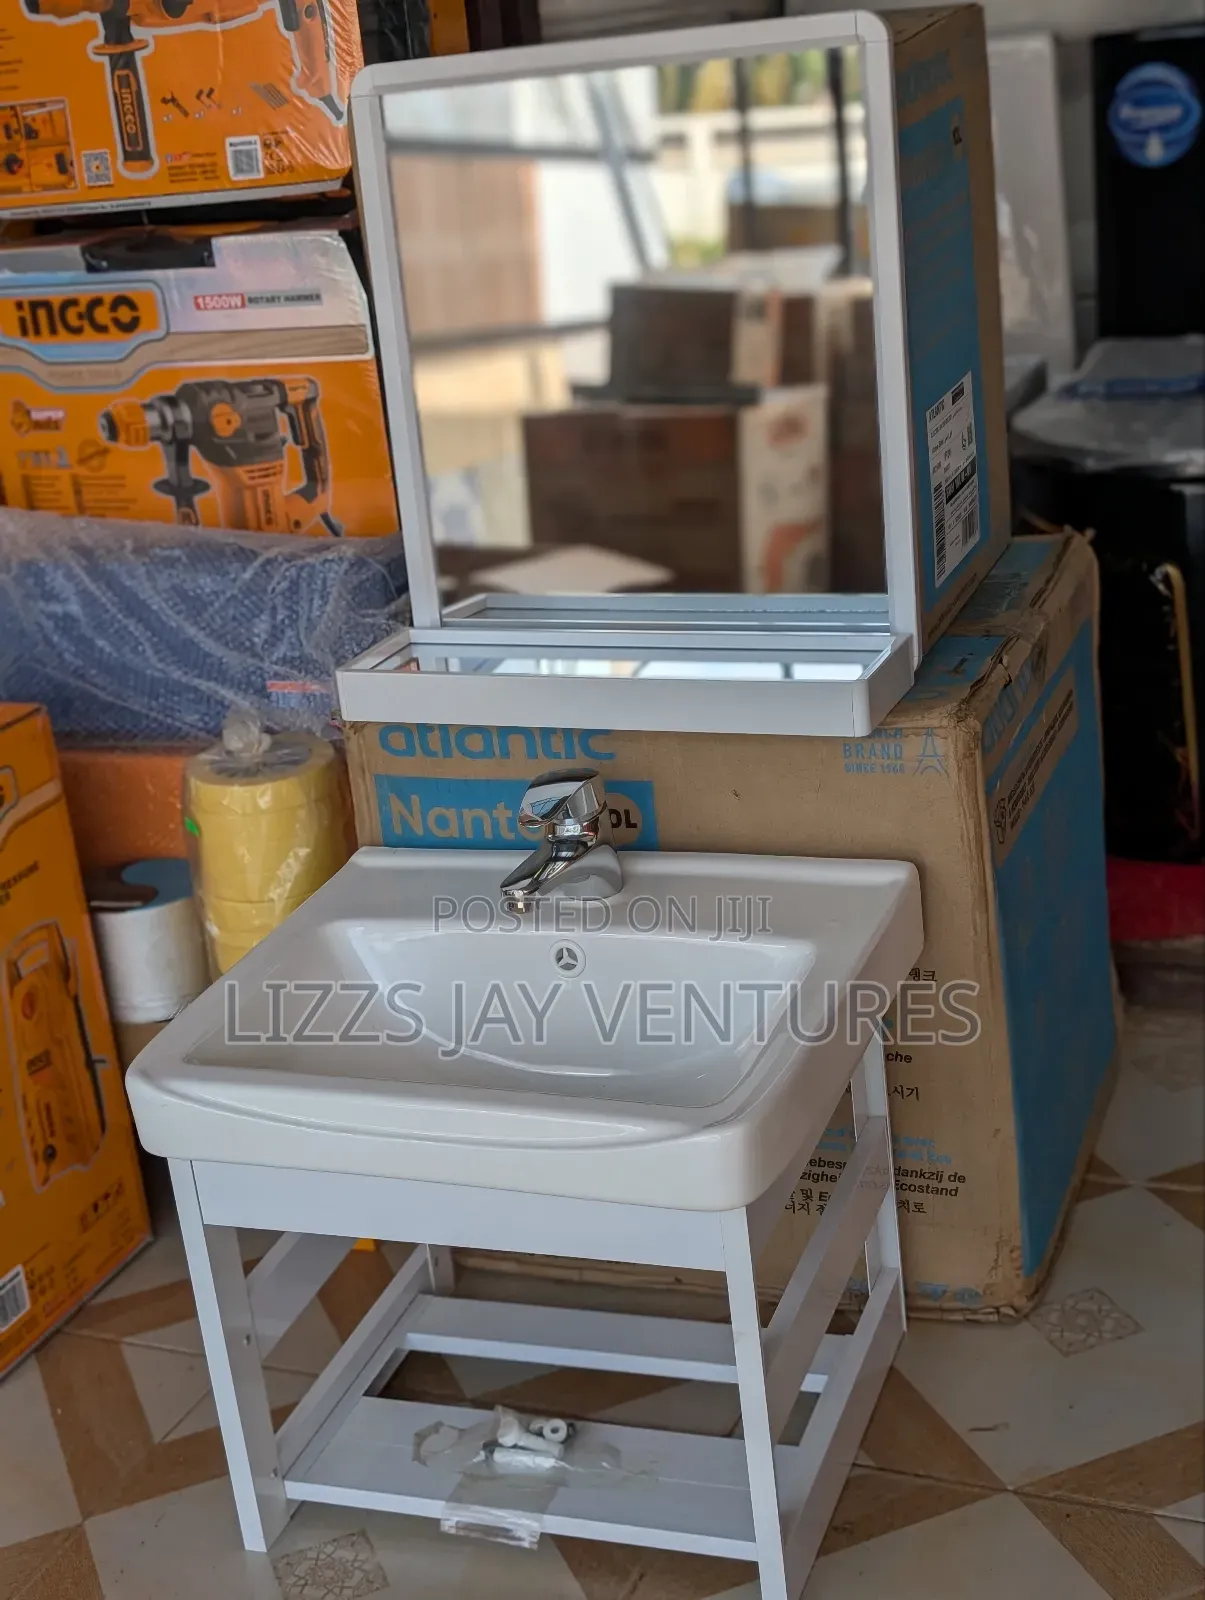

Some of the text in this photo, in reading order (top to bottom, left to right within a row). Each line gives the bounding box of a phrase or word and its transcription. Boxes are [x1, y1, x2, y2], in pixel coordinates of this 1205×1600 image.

[196, 295, 243, 309] 1500W
[379, 722, 616, 761] atlantic
[843, 742, 903, 759] BRAND
[886, 1051, 913, 1064] che
[894, 1165, 944, 1184] dankzij
[948, 1171, 966, 1184] de
